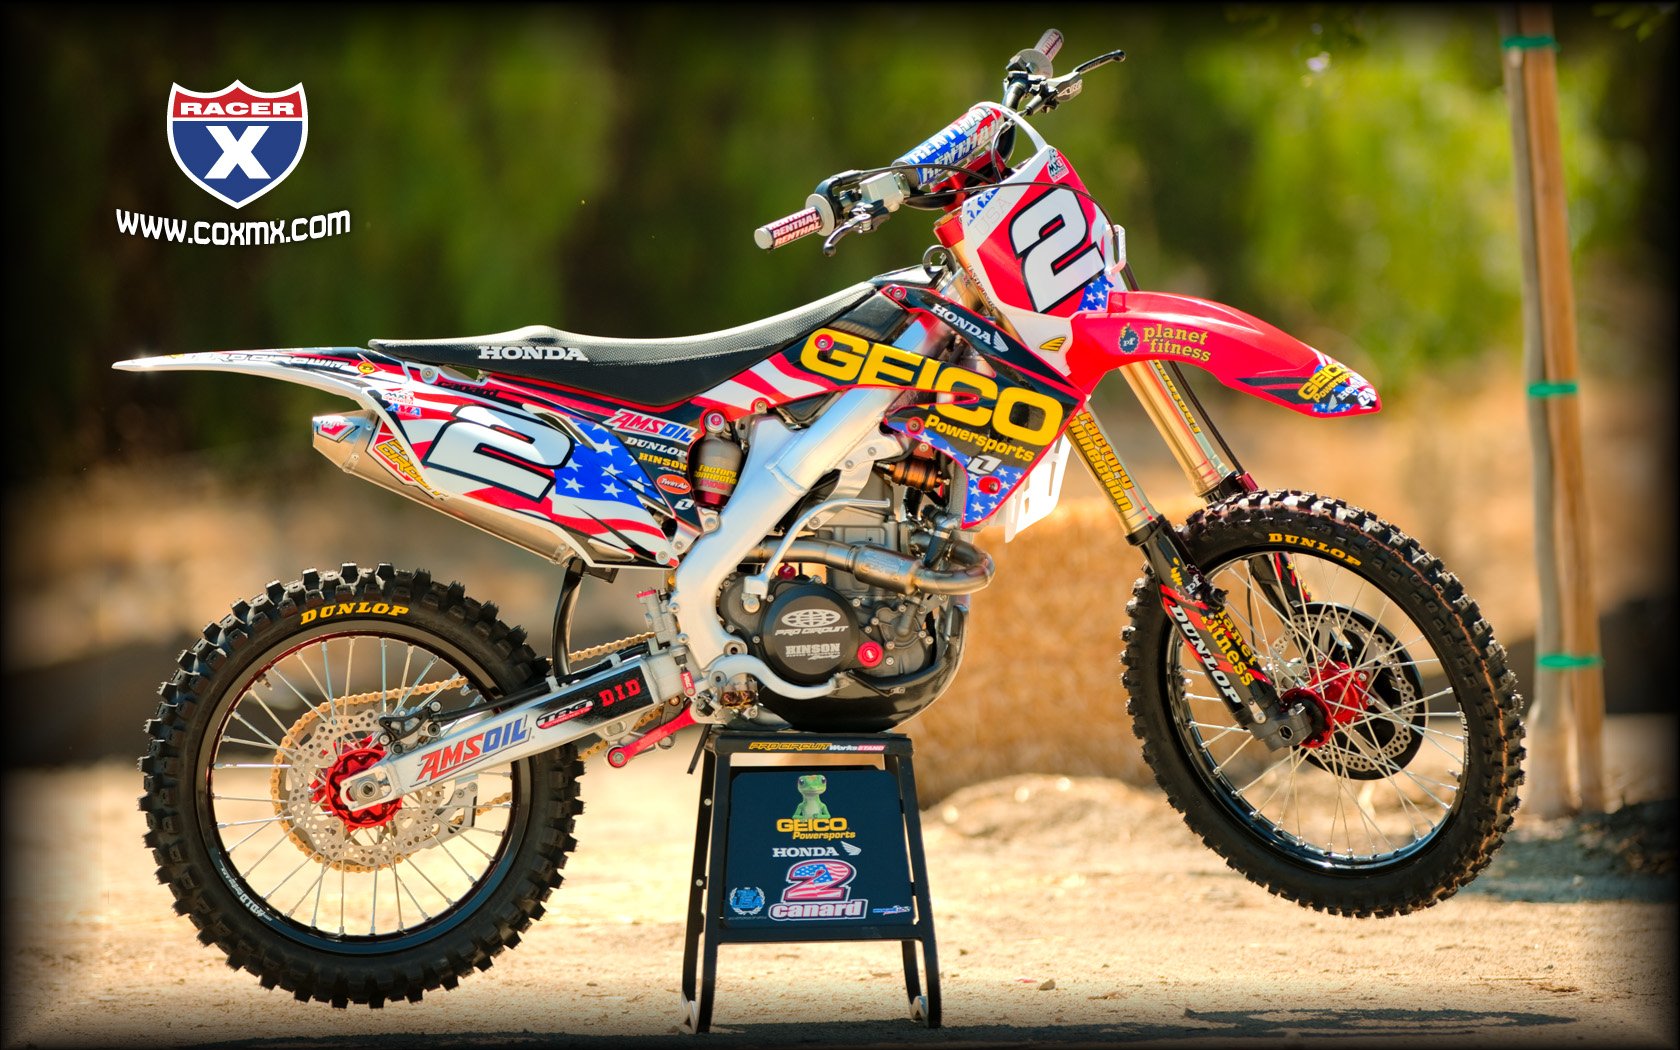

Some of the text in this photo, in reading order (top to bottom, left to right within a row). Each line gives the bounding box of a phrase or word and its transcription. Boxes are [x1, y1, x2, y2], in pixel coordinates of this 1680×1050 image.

[773, 211, 820, 239] RENTHAL
[774, 220, 822, 247] RENTHAL
[1008, 183, 1105, 313] 2
[930, 303, 992, 346] HONDA
[1142, 323, 1209, 346] planet
[477, 345, 589, 362] HONDA
[1150, 337, 1212, 362] fitness
[800, 327, 1064, 447] GEICO
[384, 402, 422, 417] AMA
[610, 411, 699, 445] AMSOIL
[924, 414, 1036, 463] Powersports
[421, 403, 575, 503] 2
[624, 436, 688, 457] DUNLOP
[1078, 411, 1135, 490] factory
[638, 452, 688, 472] HINSON
[1268, 533, 1362, 567] DUNLOP
[301, 601, 409, 626] DUNLOP
[774, 625, 849, 637] PRO CIRCUIT
[785, 643, 841, 656] HINSON
[1169, 604, 1242, 704] DUNLOP
[413, 713, 533, 784] AMSOIL
[748, 741, 779, 750] PRO
[779, 742, 832, 751] CIRCUIT
[776, 817, 848, 833] GEICO
[792, 831, 856, 841] Powersports
[772, 847, 839, 858] HONDA
[782, 859, 857, 902] 2
[771, 900, 866, 920] canard
